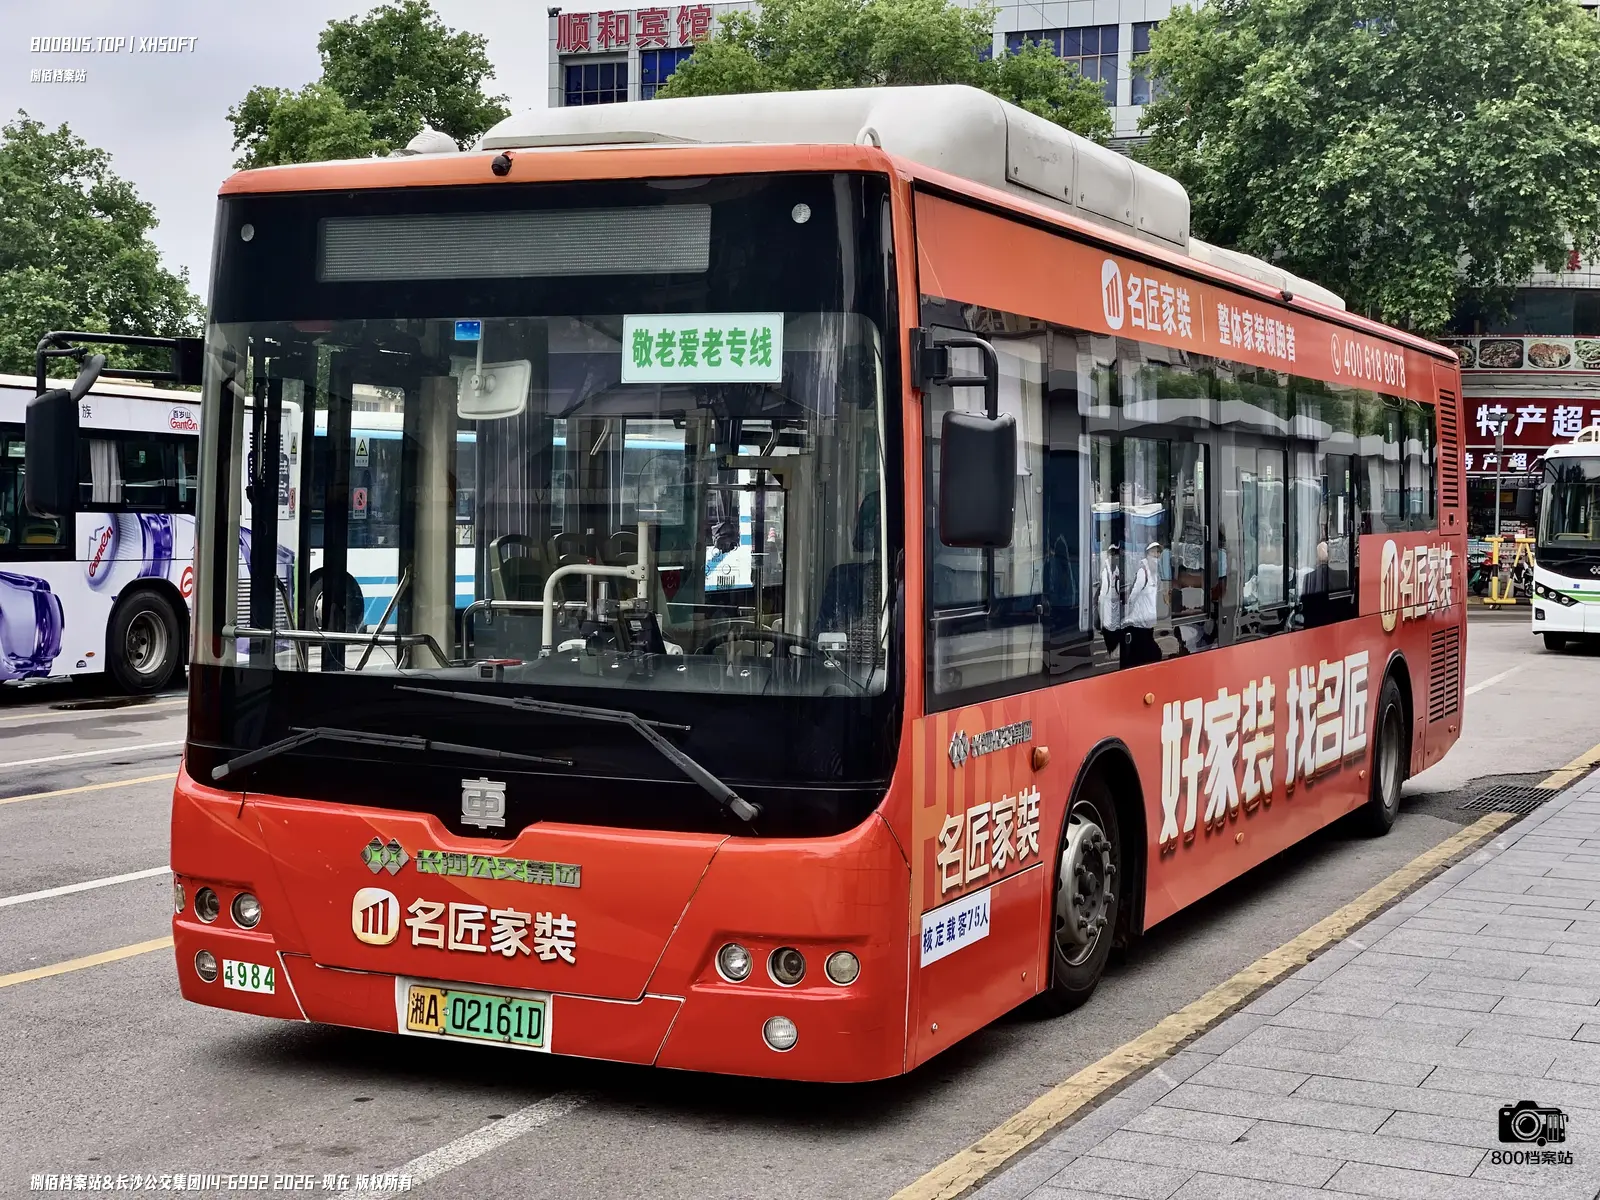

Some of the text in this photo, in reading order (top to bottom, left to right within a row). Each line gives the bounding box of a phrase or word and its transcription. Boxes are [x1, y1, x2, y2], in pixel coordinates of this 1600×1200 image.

[556, 4, 712, 53] 顺和宾馆
[632, 327, 772, 368] 敬老爱老专线
[1217, 302, 1296, 363] 整体家装领跑者
[1344, 339, 1406, 389] 400 618 8878
[1158, 649, 1370, 846] 好家装 找名匠
[414, 850, 582, 889] 长沙公交集团
[922, 902, 989, 955] 核定载客75人
[225, 960, 275, 991] 4984
